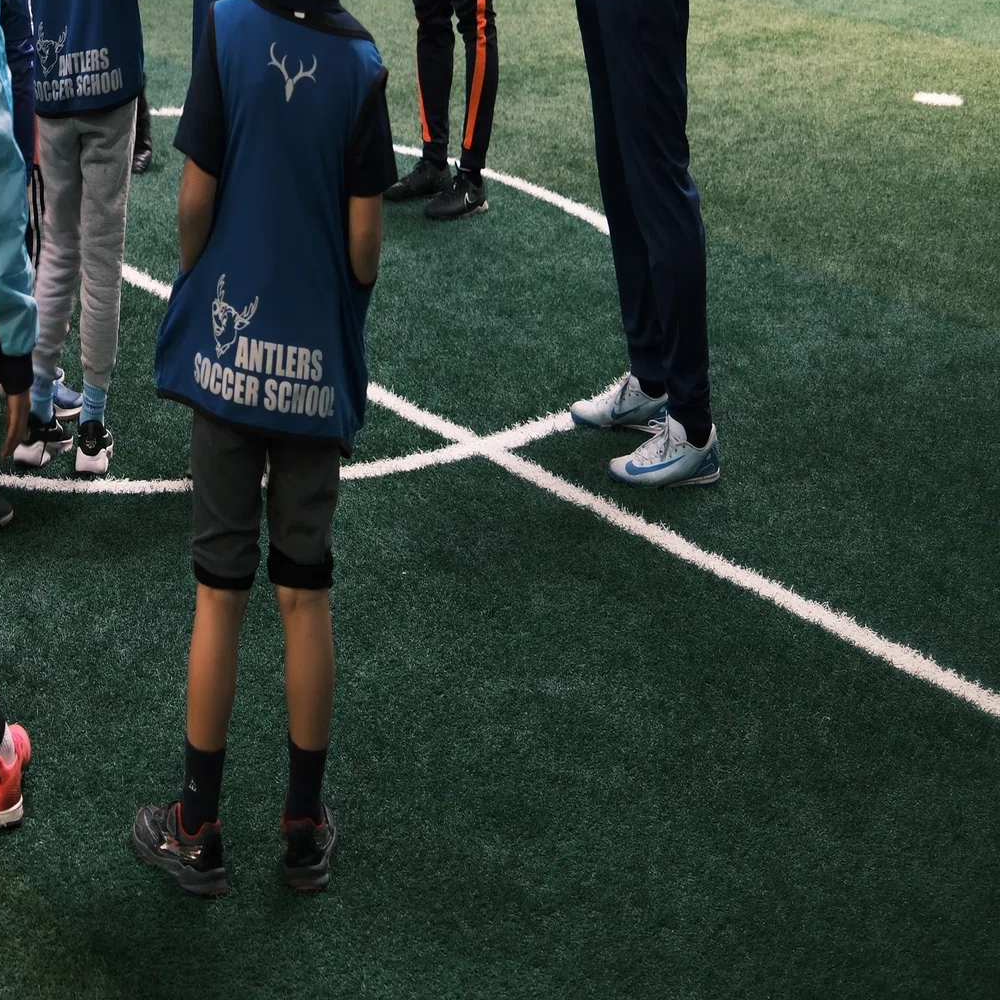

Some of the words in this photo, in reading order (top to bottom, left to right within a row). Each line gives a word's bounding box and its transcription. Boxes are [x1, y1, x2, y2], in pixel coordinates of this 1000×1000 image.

[58, 48, 110, 77] ANTLERS
[234, 336, 323, 382] ANTLERS
[193, 352, 260, 407] SOCCER
[264, 378, 335, 419] SCHOOL
